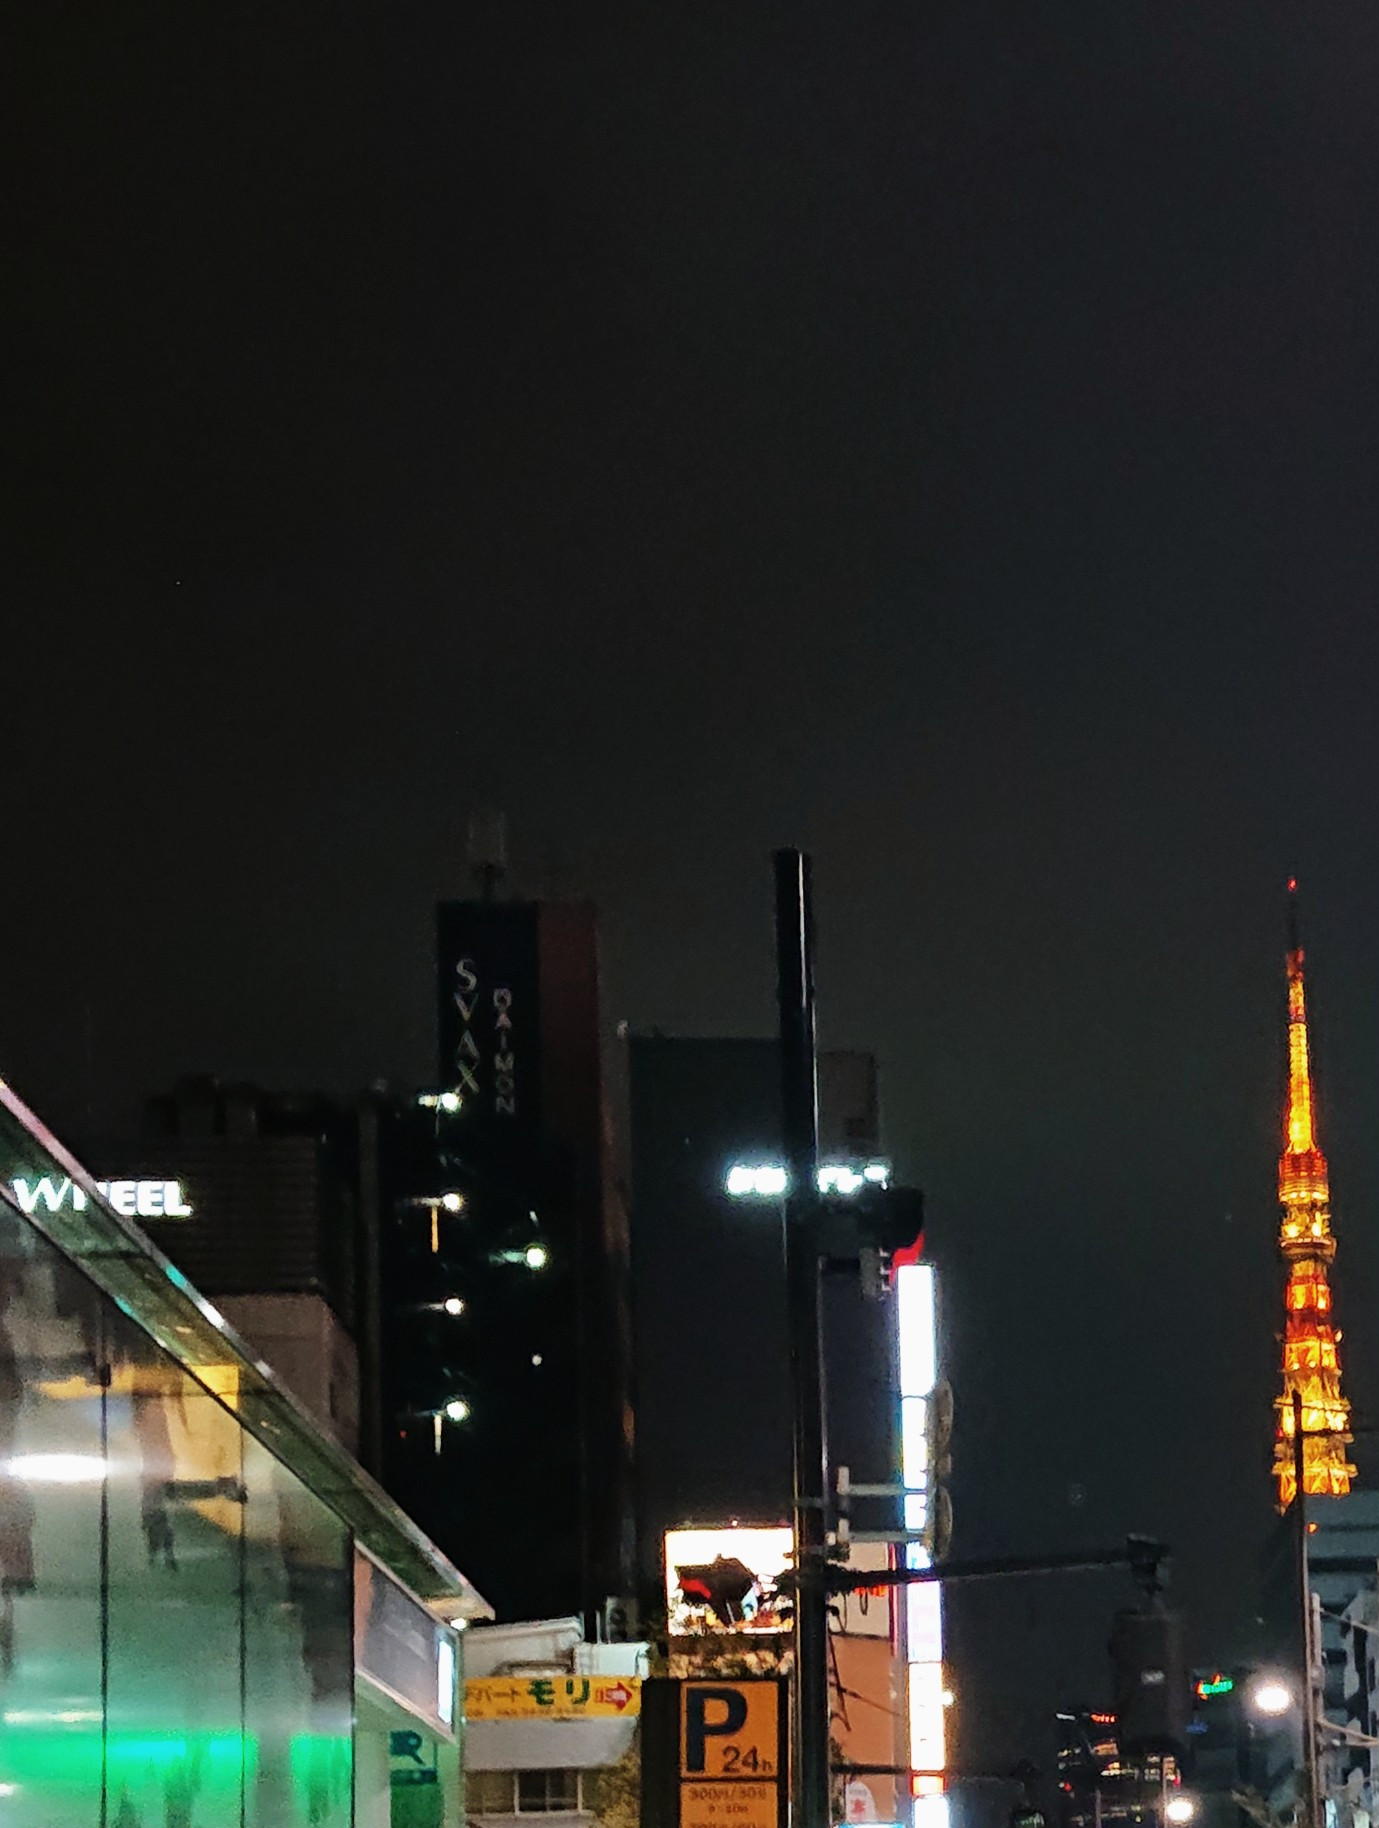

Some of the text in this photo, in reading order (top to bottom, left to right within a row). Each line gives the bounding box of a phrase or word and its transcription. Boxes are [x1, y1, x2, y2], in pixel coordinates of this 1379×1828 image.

[528, 1679, 590, 1706] モリ
[687, 1687, 748, 1772] P
[722, 1745, 773, 1773] 24h
